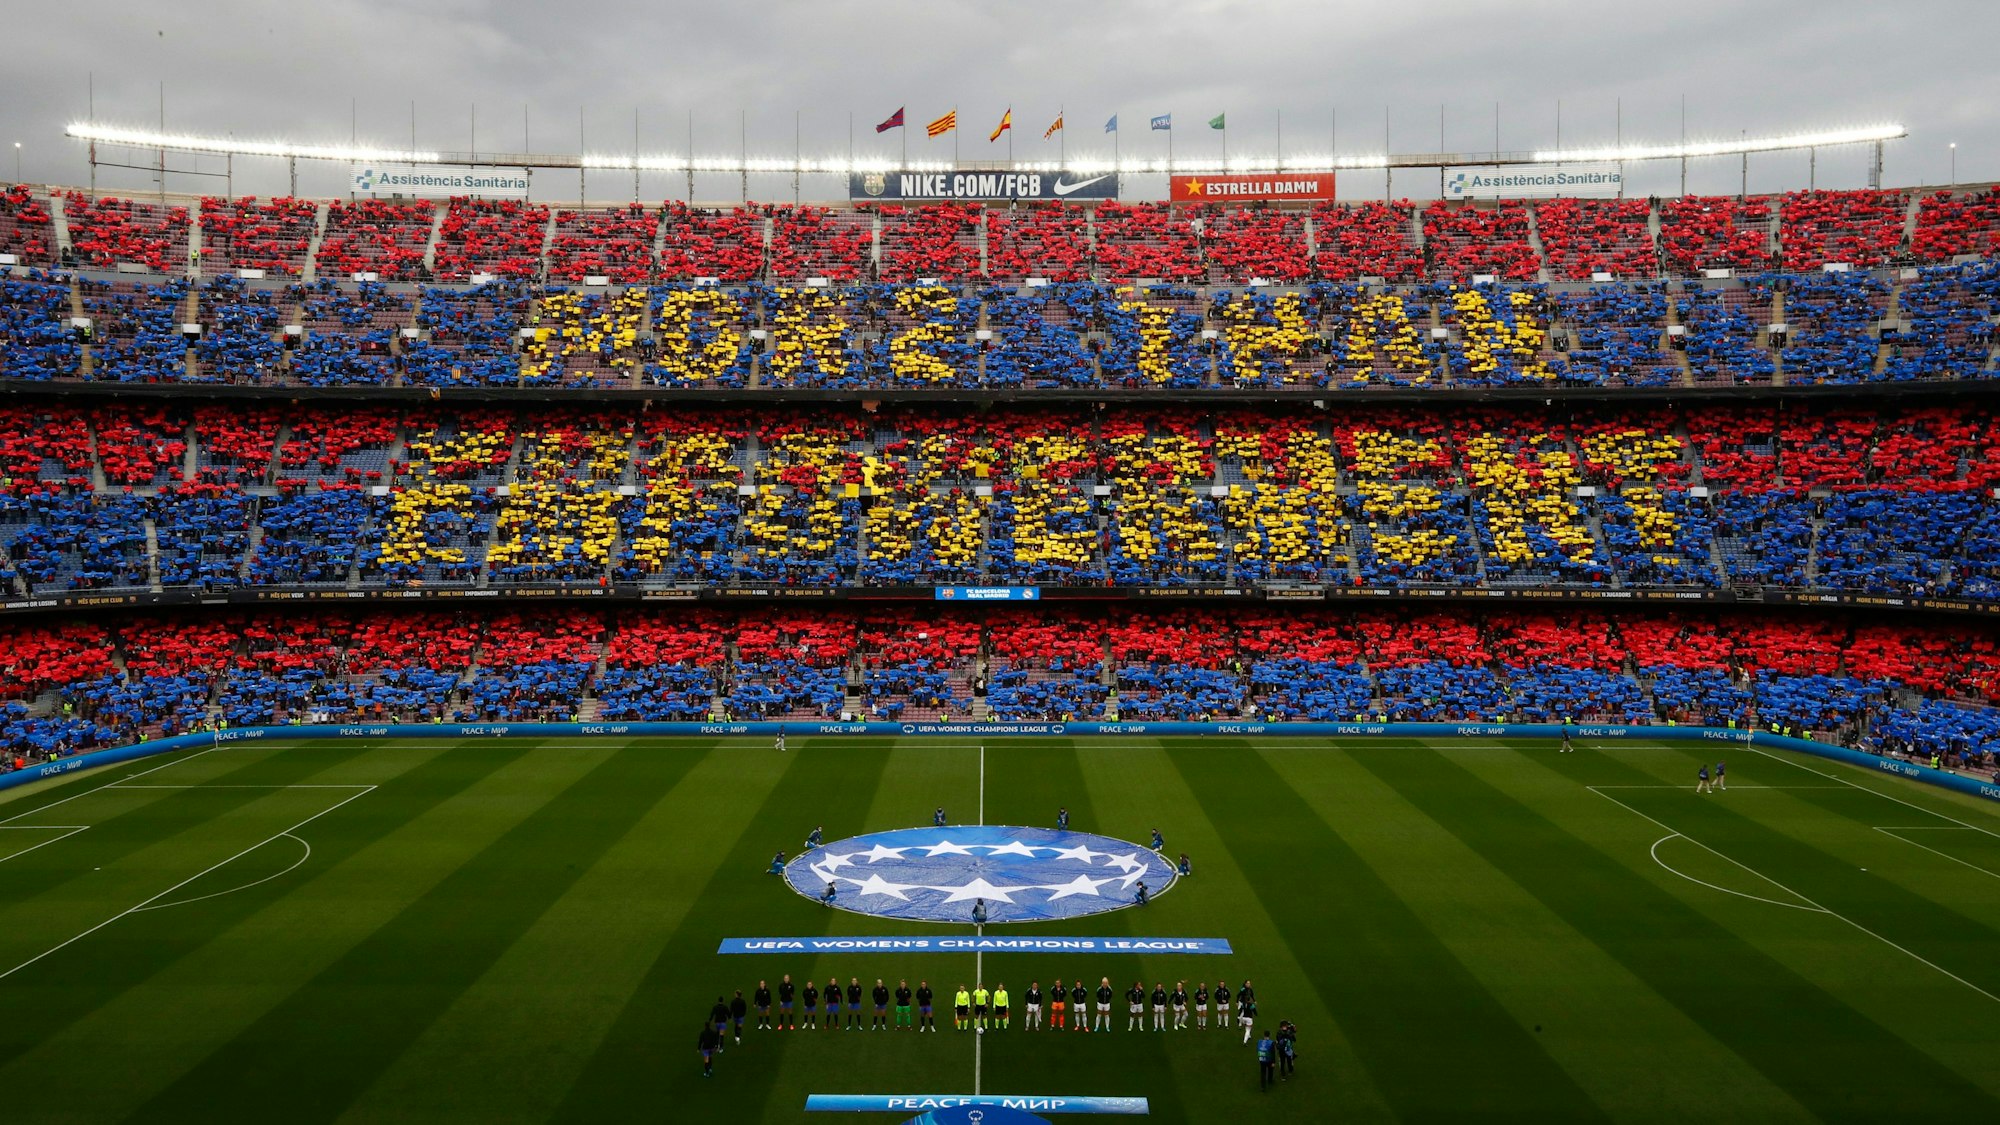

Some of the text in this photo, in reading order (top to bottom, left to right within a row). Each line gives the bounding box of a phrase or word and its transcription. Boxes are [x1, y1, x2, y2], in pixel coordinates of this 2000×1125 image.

[379, 171, 526, 189] Assistència Sanitària
[900, 174, 1041, 197] NIKE.COM/FCB
[1472, 172, 1621, 187] Assistència Sanitària
[1206, 181, 1318, 196] ESTRELLA DAMM
[214, 731, 238, 741] PEACE
[245, 730, 264, 738] МИР
[340, 728, 363, 736] PEACE
[490, 727, 509, 735] МИР
[610, 726, 629, 734] МИР
[1458, 727, 1480, 735] PEACE
[1579, 728, 1602, 736] PEACE
[1703, 730, 1728, 739] PEACE
[1736, 734, 1754, 742] МИР
[41, 765, 62, 776] PEACE
[66, 760, 82, 770] МИР
[1880, 761, 1899, 772] PEACE
[1905, 767, 1920, 776] МИР
[745, 939, 1200, 950] UEFA WOMEN'S CHAMPIONS LEAGUE
[887, 1098, 971, 1109] PEACE
[1002, 1099, 1066, 1110] МИР
